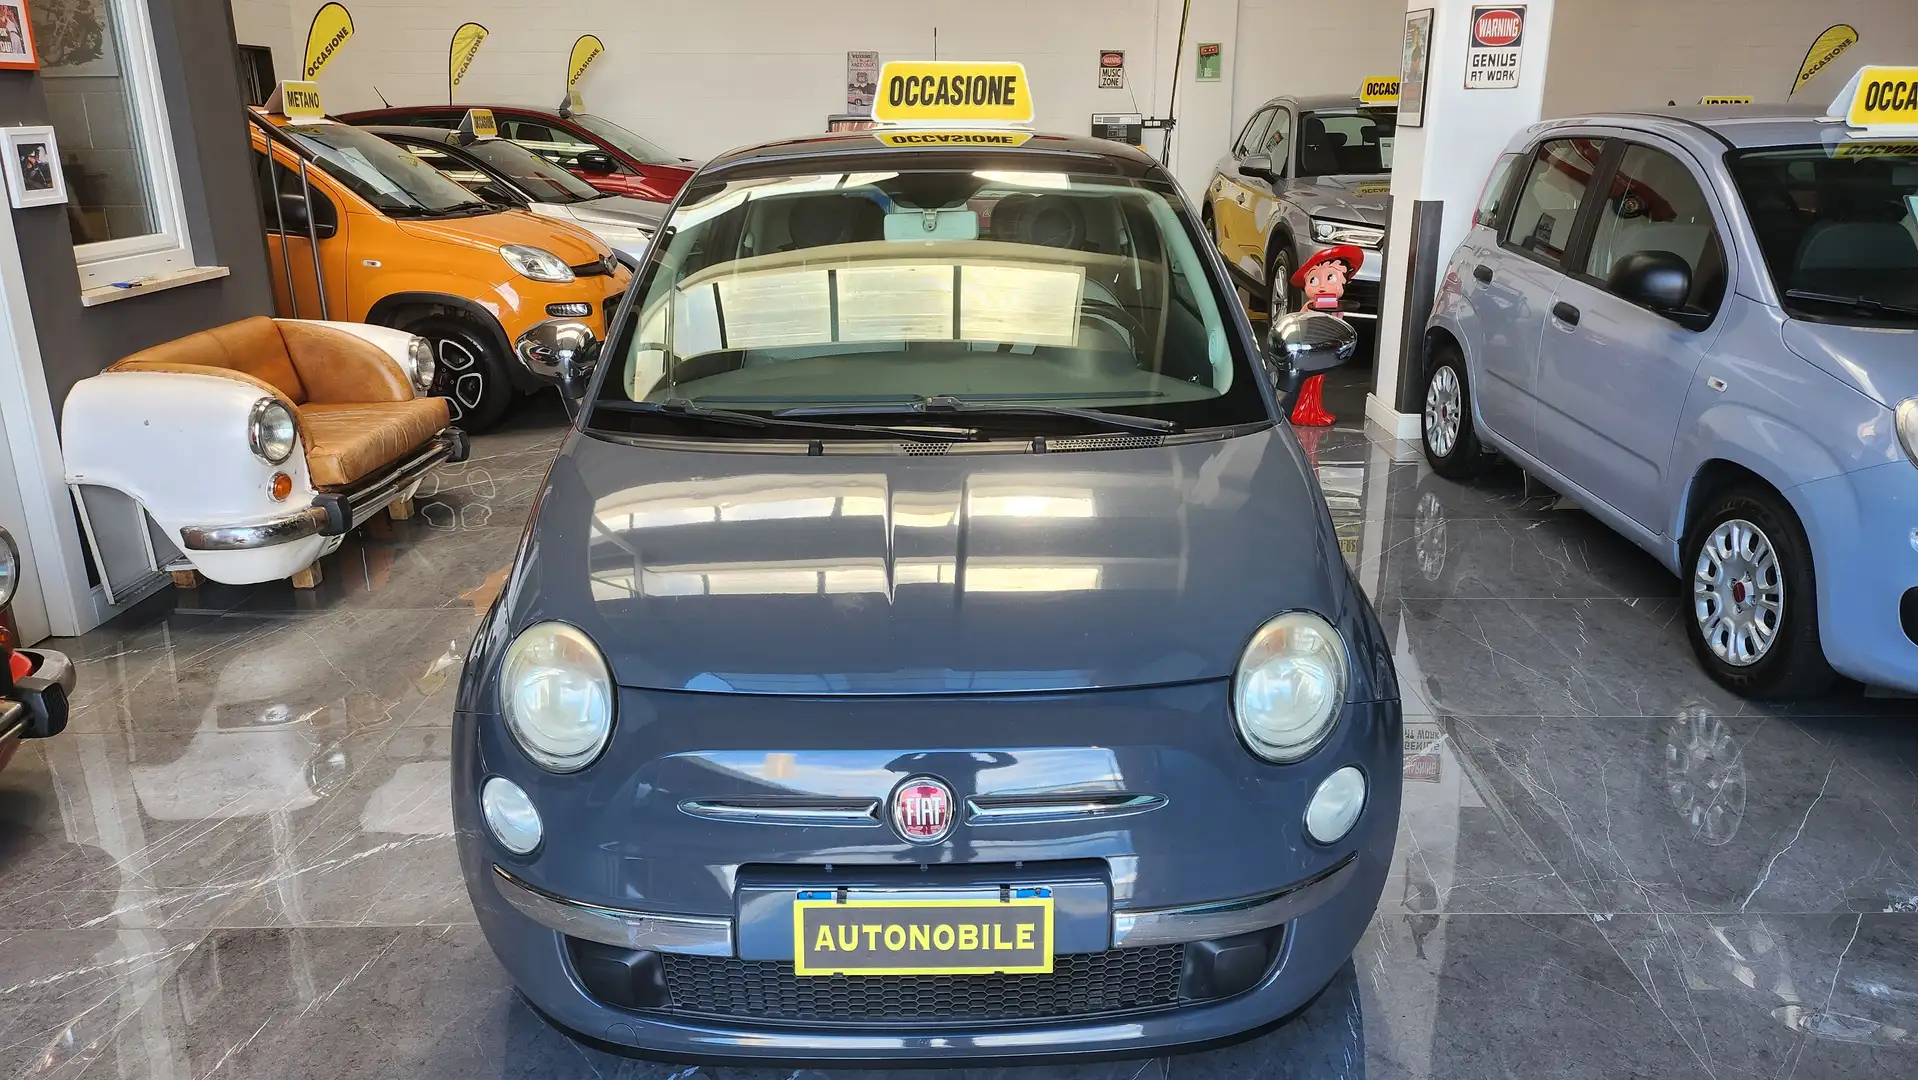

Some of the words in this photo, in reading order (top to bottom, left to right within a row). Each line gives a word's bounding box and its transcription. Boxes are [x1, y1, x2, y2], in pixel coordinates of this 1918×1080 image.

[1479, 18, 1520, 38] WARNING
[307, 26, 349, 77] OCCASIONE
[453, 34, 485, 86] OCCASIONE
[1472, 53, 1516, 67] GENIUS
[1801, 37, 1853, 81] OCCASIONE
[570, 47, 601, 86] OCCASIONE
[1102, 68, 1121, 77] MUSIC
[1471, 71, 1482, 81] AT
[1487, 70, 1515, 81] WORK
[889, 75, 1017, 107] OCCASIONE
[1102, 78, 1119, 86] ZONE
[1864, 81, 1918, 112] OCCA
[287, 90, 320, 109] METANO
[906, 797, 942, 826] FIAT
[814, 922, 1035, 951] AUTONOBILE
